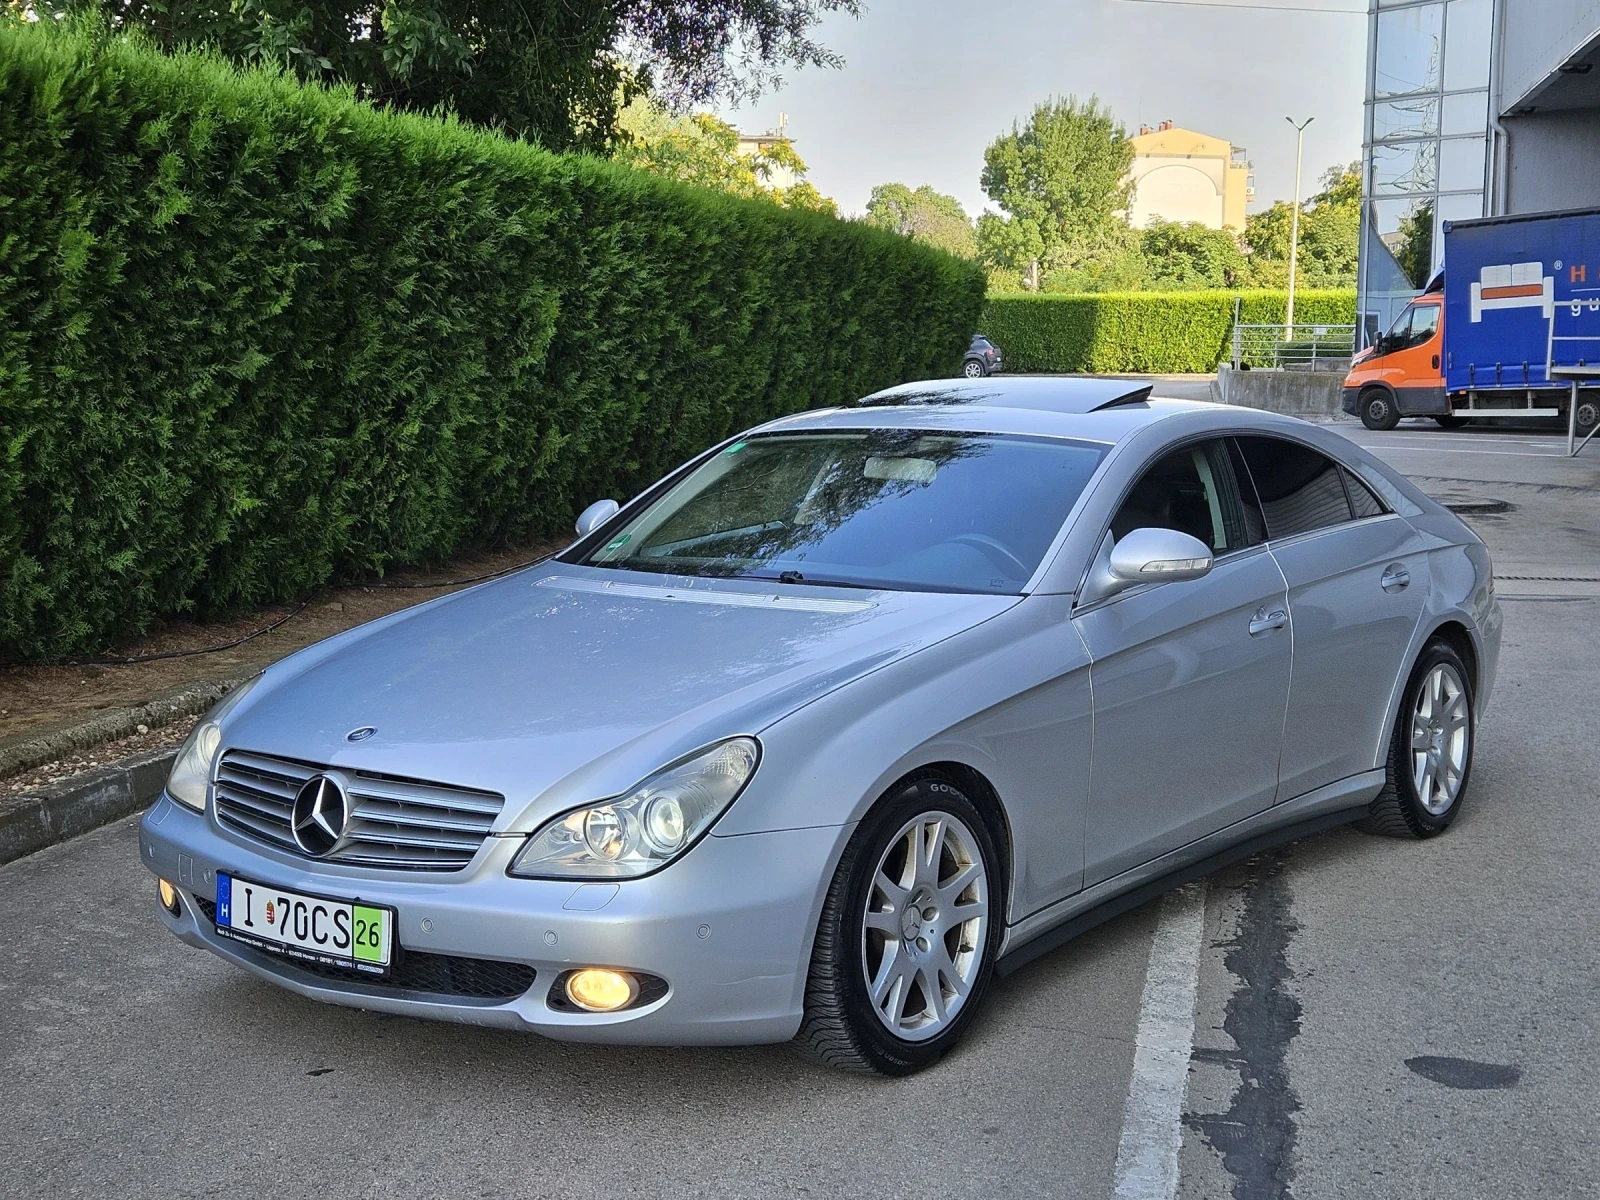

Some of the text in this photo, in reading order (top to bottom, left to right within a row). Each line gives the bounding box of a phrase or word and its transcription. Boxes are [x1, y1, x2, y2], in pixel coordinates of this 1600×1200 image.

[221, 904, 228, 918] H
[244, 888, 350, 949] I 70CS
[355, 920, 379, 947] 26
